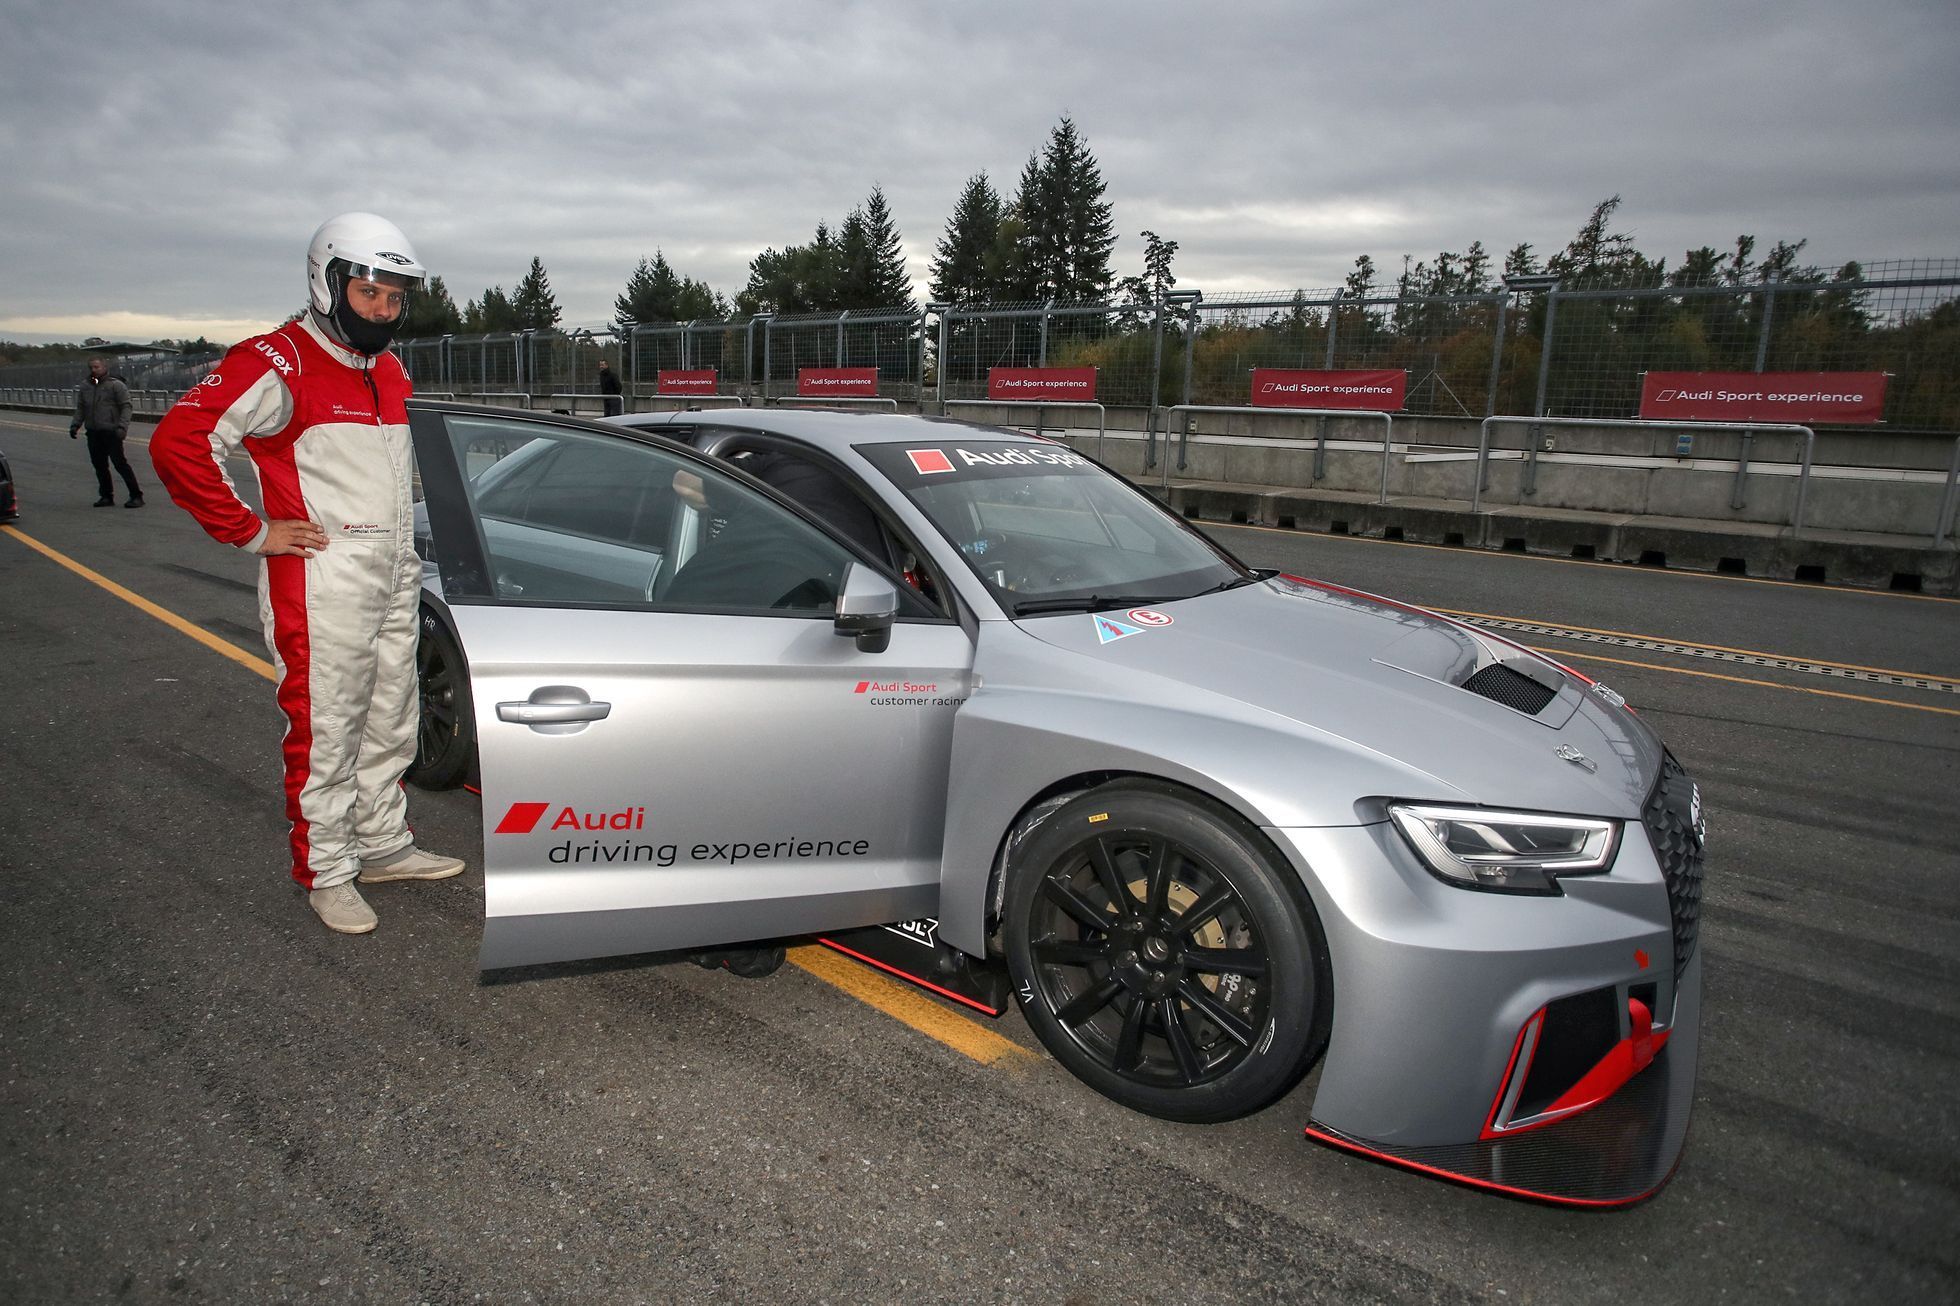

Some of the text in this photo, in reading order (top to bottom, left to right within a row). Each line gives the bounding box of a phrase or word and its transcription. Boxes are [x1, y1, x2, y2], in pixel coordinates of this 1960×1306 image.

[254, 340, 294, 375] uvex
[1023, 380, 1044, 388] Sport
[1045, 380, 1088, 388] experience
[1274, 383, 1393, 394] Audi Sport experience
[1676, 390, 1864, 403] Audi Sport experience
[955, 448, 1040, 466] Audi
[871, 682, 937, 694] Audi Sport
[870, 697, 929, 706] customer
[549, 807, 646, 831] Audi
[548, 837, 870, 867] driving experience
